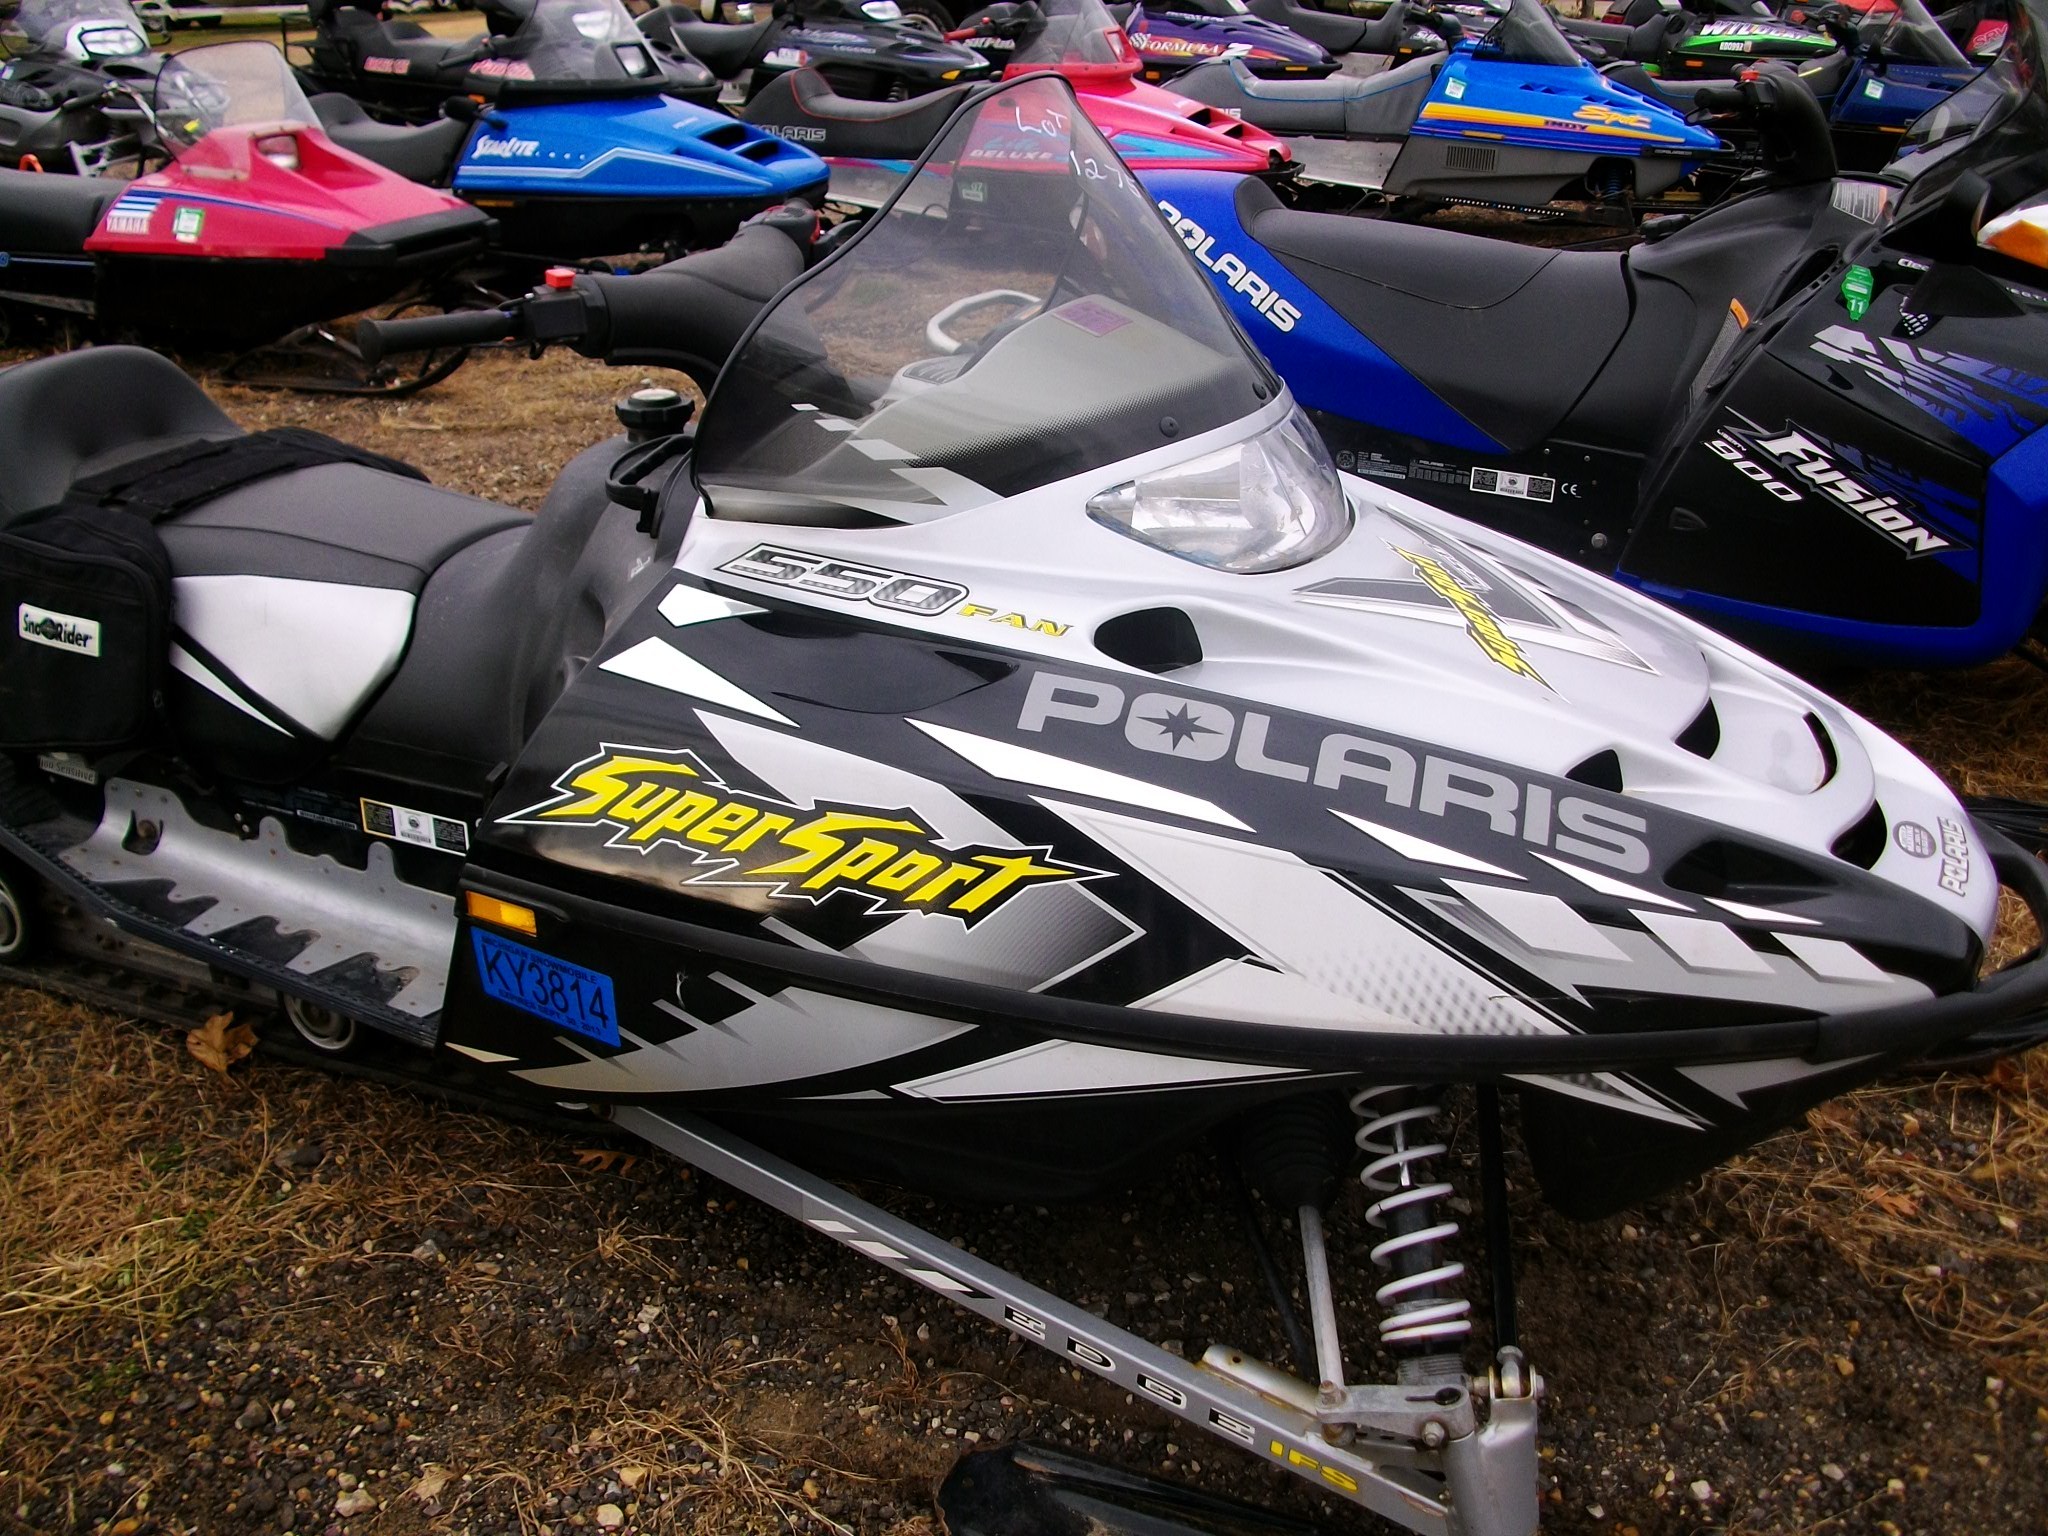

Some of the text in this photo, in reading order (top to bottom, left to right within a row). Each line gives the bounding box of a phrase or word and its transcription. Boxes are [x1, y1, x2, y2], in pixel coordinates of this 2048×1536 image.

[969, 149, 1053, 160] DELUXE
[1544, 118, 1589, 131] INDY
[1703, 439, 1803, 502] 900
[720, 546, 1074, 638] 550 FAN
[1016, 671, 1651, 874] POLARIS
[1937, 815, 1970, 898] POLARIS
[481, 943, 609, 1030] KY3814
[530, 953, 598, 984] SNOWMOBILE
[1005, 1304, 1359, 1494] EDGE IFS
